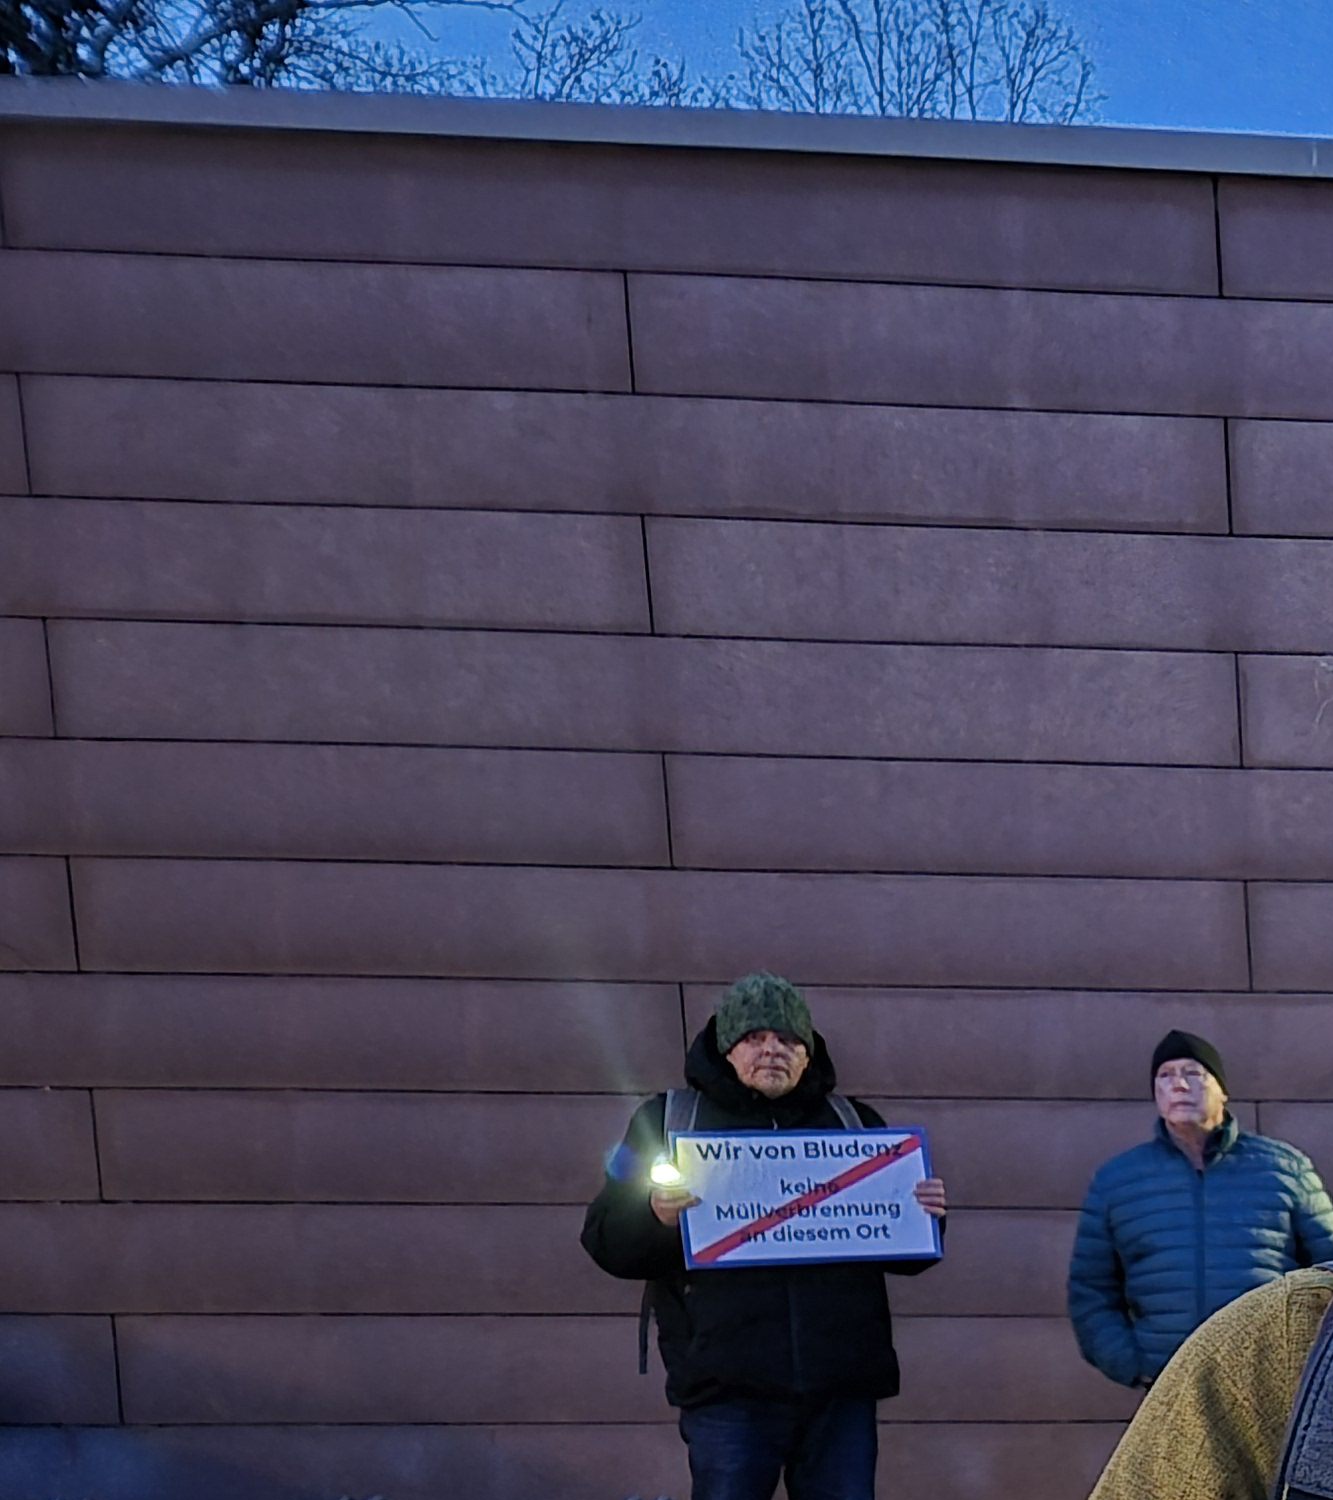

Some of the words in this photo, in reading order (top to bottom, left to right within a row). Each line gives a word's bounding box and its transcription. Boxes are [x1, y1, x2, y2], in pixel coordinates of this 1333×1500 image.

[696, 1140, 742, 1160] Wir
[751, 1142, 795, 1159] von
[804, 1139, 902, 1159] Bludenz
[780, 1178, 839, 1194] keine
[716, 1199, 901, 1221] Müllverbrennung
[740, 1229, 766, 1243] an
[773, 1226, 850, 1243] diesem
[856, 1224, 891, 1240] Ort
